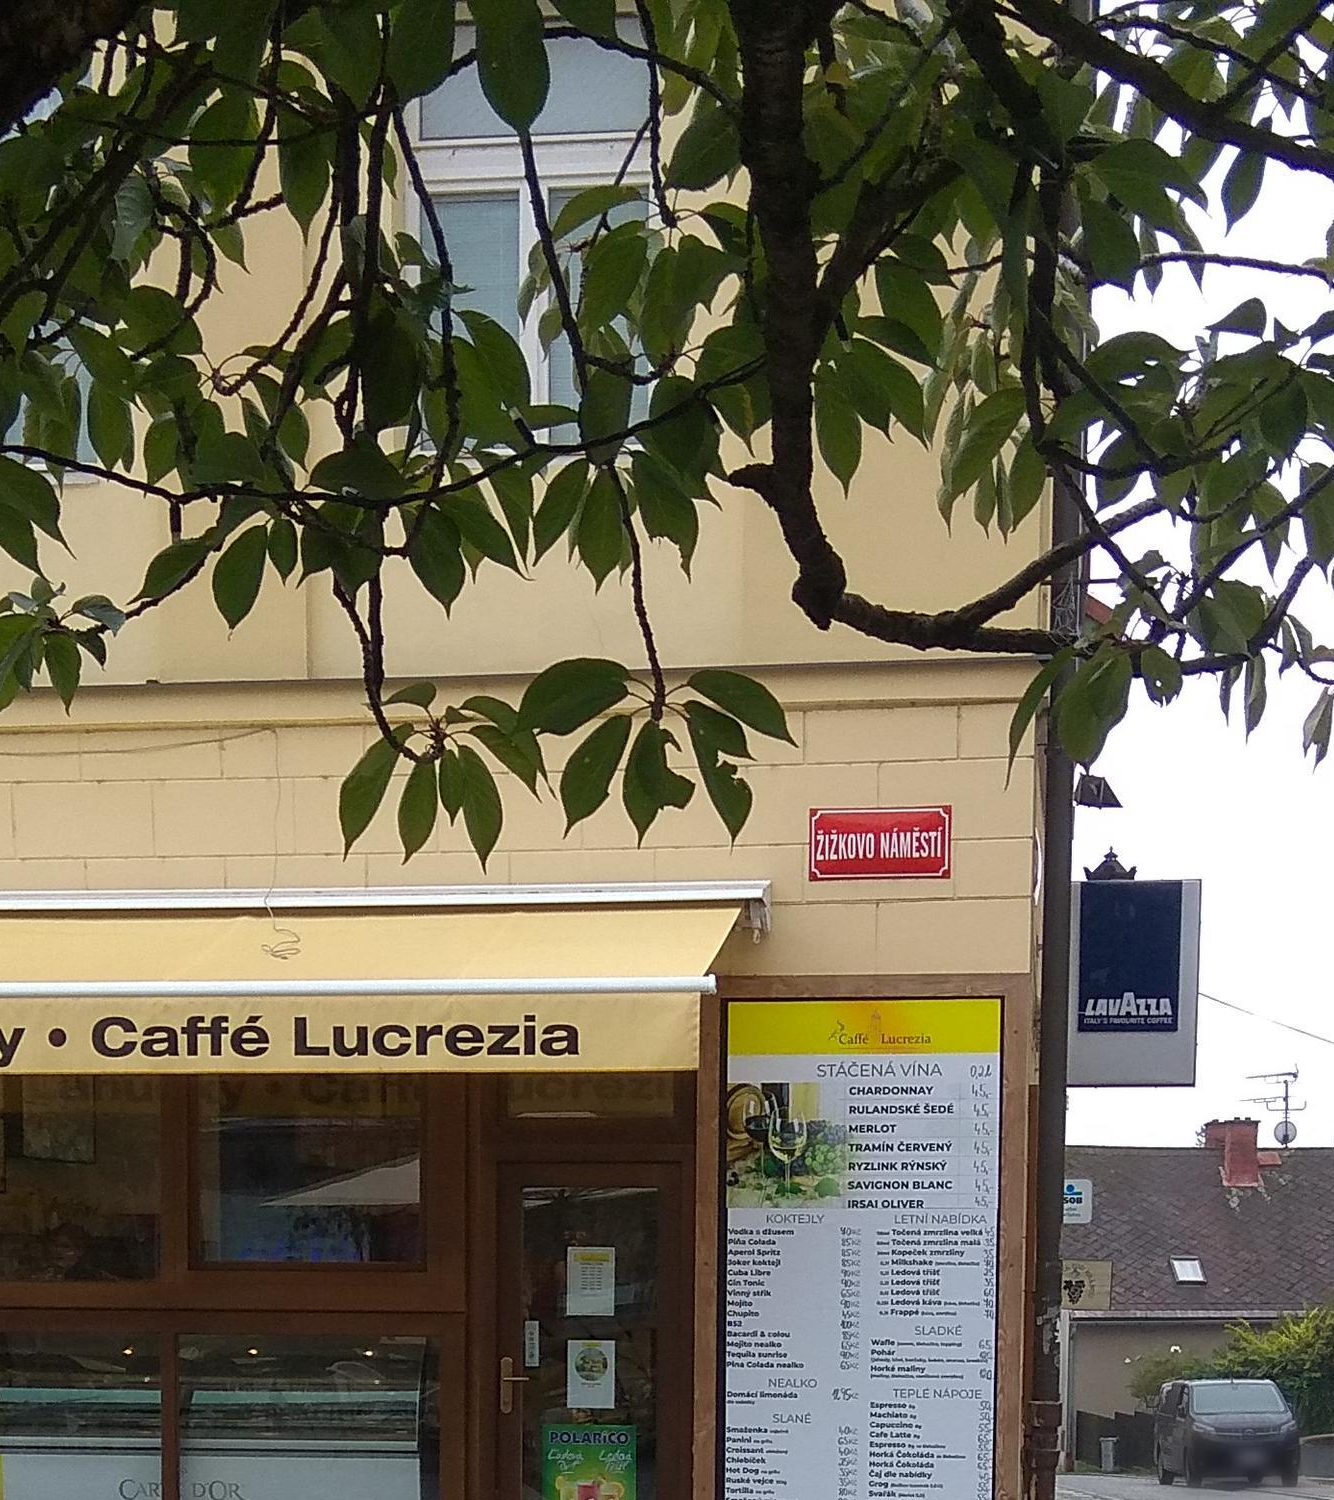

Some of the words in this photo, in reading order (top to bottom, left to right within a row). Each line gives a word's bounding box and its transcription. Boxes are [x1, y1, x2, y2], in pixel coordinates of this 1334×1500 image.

[816, 829, 875, 861] ŽIŽKOVO
[879, 826, 943, 859] NÁMĚSTÍ
[1084, 991, 1173, 1016] LAVAZZA
[91, 1014, 270, 1057] Caffé
[293, 1014, 580, 1057] Lucrezia
[838, 1032, 869, 1045] Caffé
[881, 1033, 931, 1044] Lucrezia
[817, 1060, 896, 1078] STÁČENÁ
[901, 1063, 943, 1077] VÍNA
[849, 1086, 933, 1096] CHARDONNAY
[849, 1104, 919, 1114] RULANDSKÉ
[923, 1104, 954, 1114] ŠEDÉ
[849, 1124, 896, 1134] MERLOT
[849, 1142, 894, 1152] TRAMÍN
[898, 1140, 953, 1152] ČERVENÝ
[849, 1162, 897, 1171] RYZLINK
[901, 1160, 947, 1171] RÝNSKÝ
[847, 1180, 909, 1190] SAVIGNON
[913, 1180, 953, 1190] BLANC
[847, 1200, 879, 1208] IRSAI
[881, 1200, 924, 1208] OLIVER
[766, 1214, 825, 1223] KOKTEJLY
[895, 1213, 928, 1224] LETNÍ
[931, 1213, 987, 1224] NABÍDKA
[892, 1249, 927, 1257] Kopeček
[929, 1249, 965, 1257] zmrzliny
[727, 1300, 753, 1308] Mojito
[727, 1310, 759, 1318] Chupito
[890, 1309, 919, 1317] Frappé
[915, 1325, 962, 1336] SLADKÉ
[768, 1379, 817, 1388] NEALKO
[933, 1387, 982, 1399] NÁPOJE
[870, 1402, 907, 1410] Espresso
[773, 1412, 811, 1423] SLANÉ
[896, 1450, 934, 1458] Čokoláda
[896, 1460, 934, 1468] Čokoláda
[869, 1471, 882, 1479] Čaj
